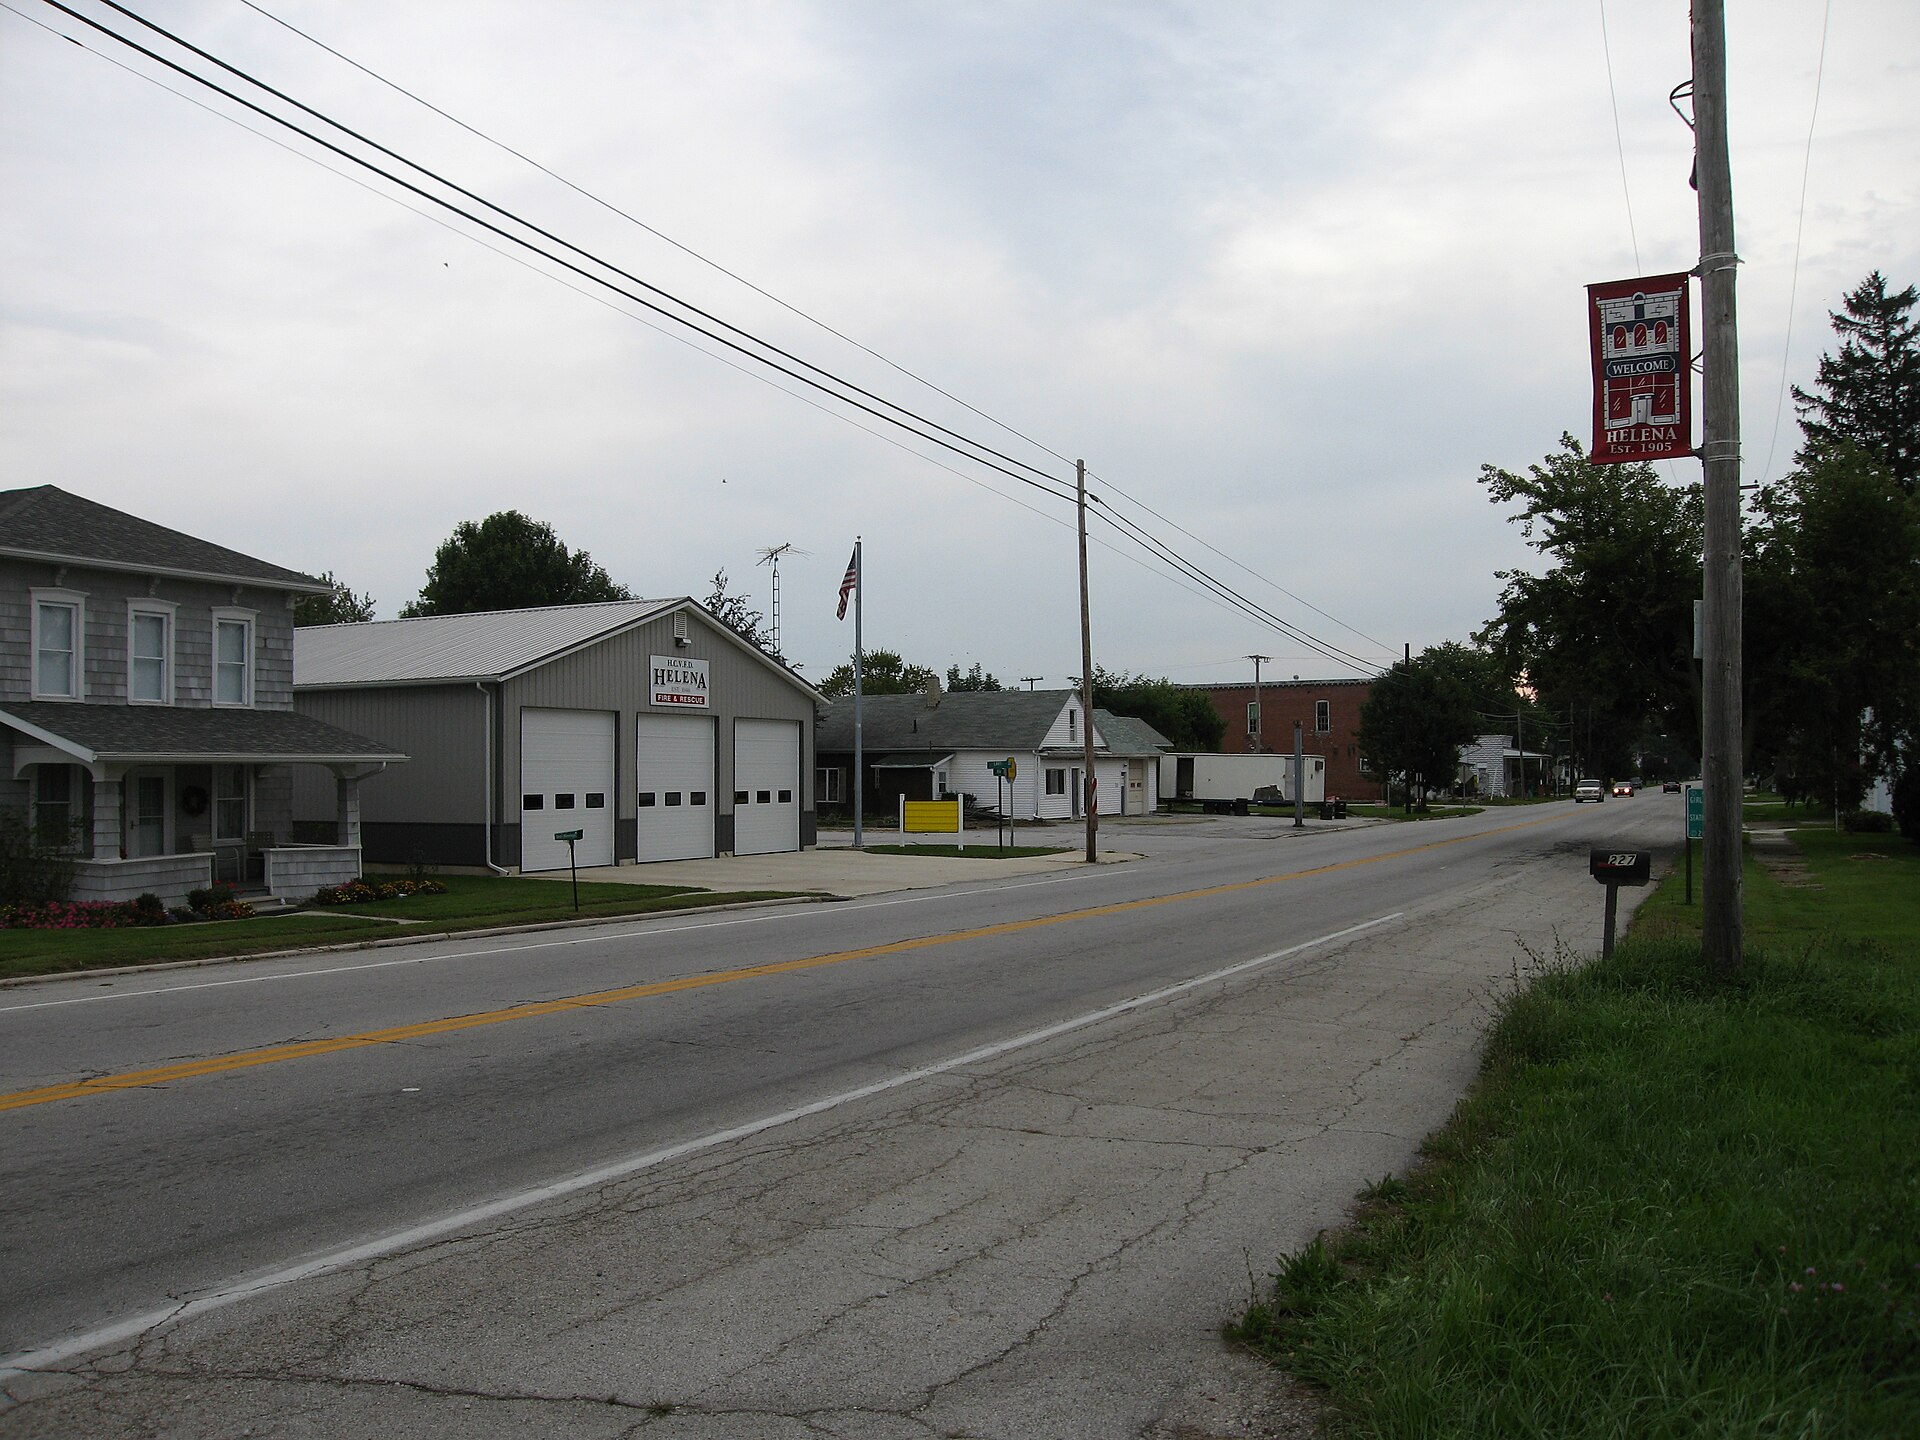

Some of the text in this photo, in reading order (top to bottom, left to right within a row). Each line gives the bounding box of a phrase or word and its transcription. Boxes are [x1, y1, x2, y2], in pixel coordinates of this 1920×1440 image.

[1613, 360, 1669, 374] WELCOME
[1606, 427, 1677, 443] HELENA
[1610, 442, 1672, 454] EST. 1905
[654, 668, 706, 688] HELENA
[1609, 855, 1636, 865] 227
